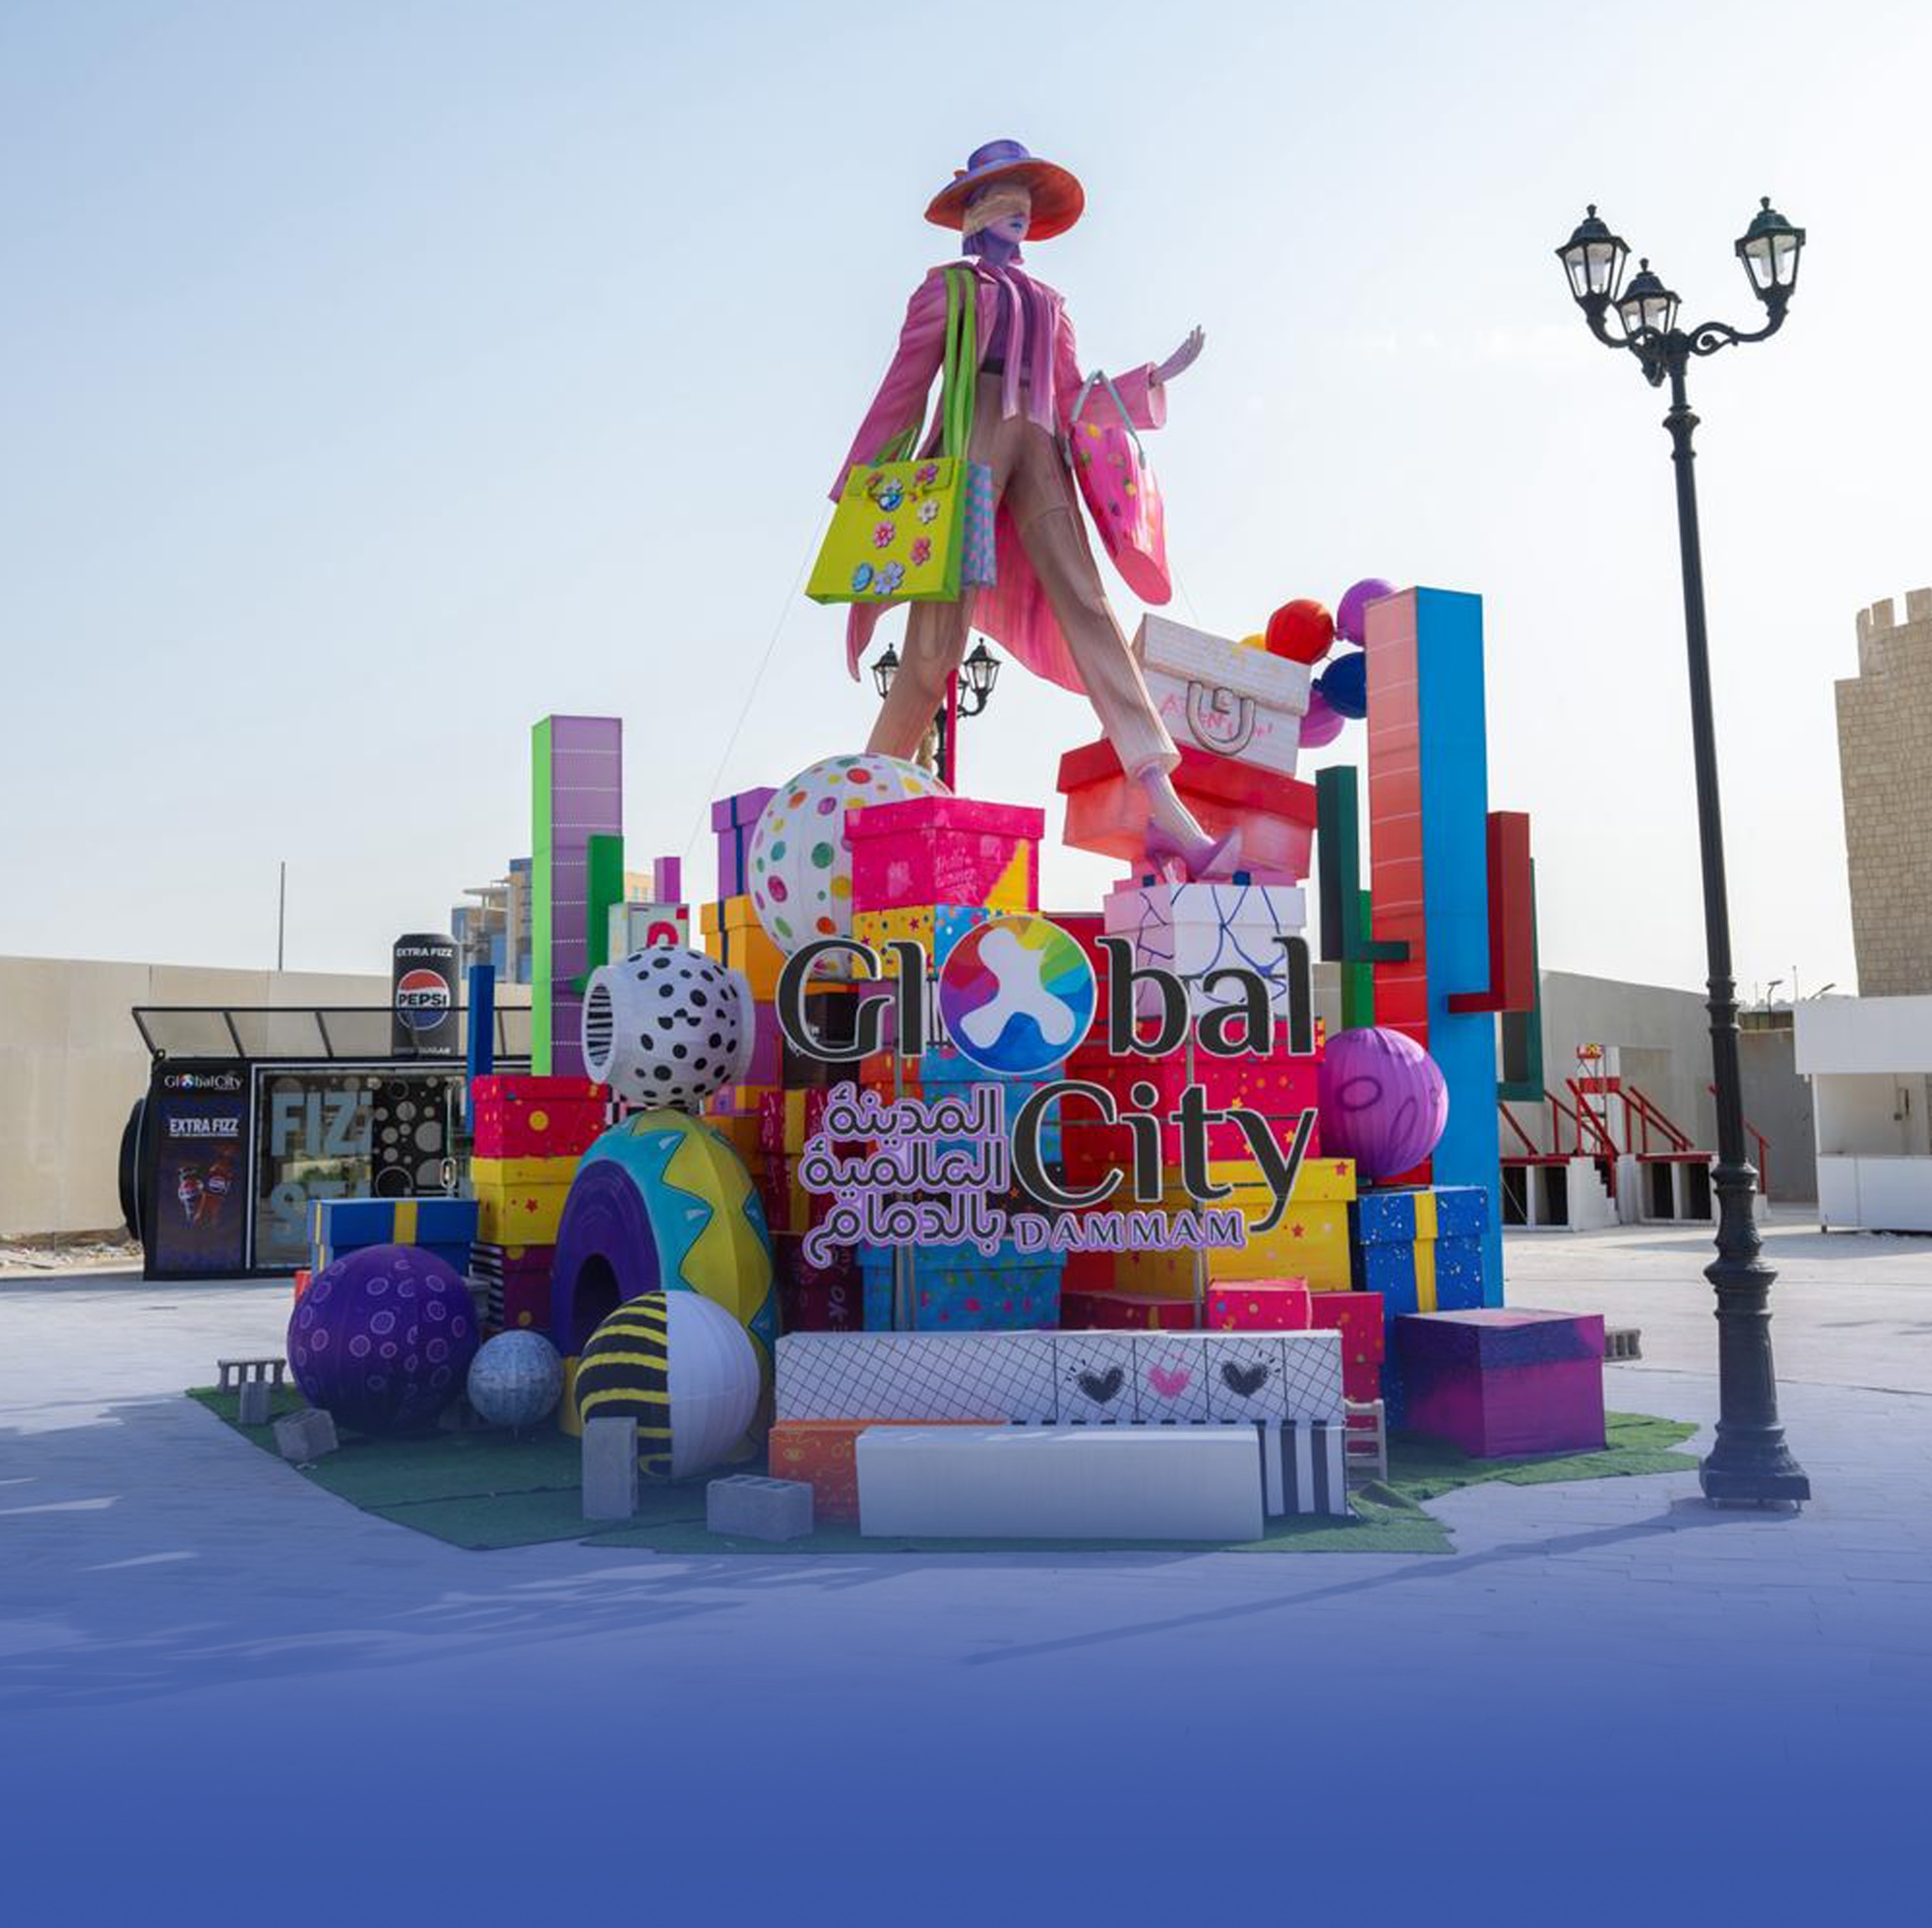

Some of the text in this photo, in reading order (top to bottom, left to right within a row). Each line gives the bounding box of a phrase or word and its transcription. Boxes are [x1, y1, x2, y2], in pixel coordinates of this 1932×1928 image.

[430, 948, 453, 957] FIZZ
[399, 994, 446, 1006] PEPSI
[169, 1118, 240, 1133] EXTRA FIZZ
[825, 1083, 1003, 1147] المدينة
[802, 1136, 1008, 1200] العالمية
[1011, 1080, 1317, 1233] City
[805, 1193, 1003, 1265] بالدمام
[1016, 1211, 1244, 1249] DAMMAM
